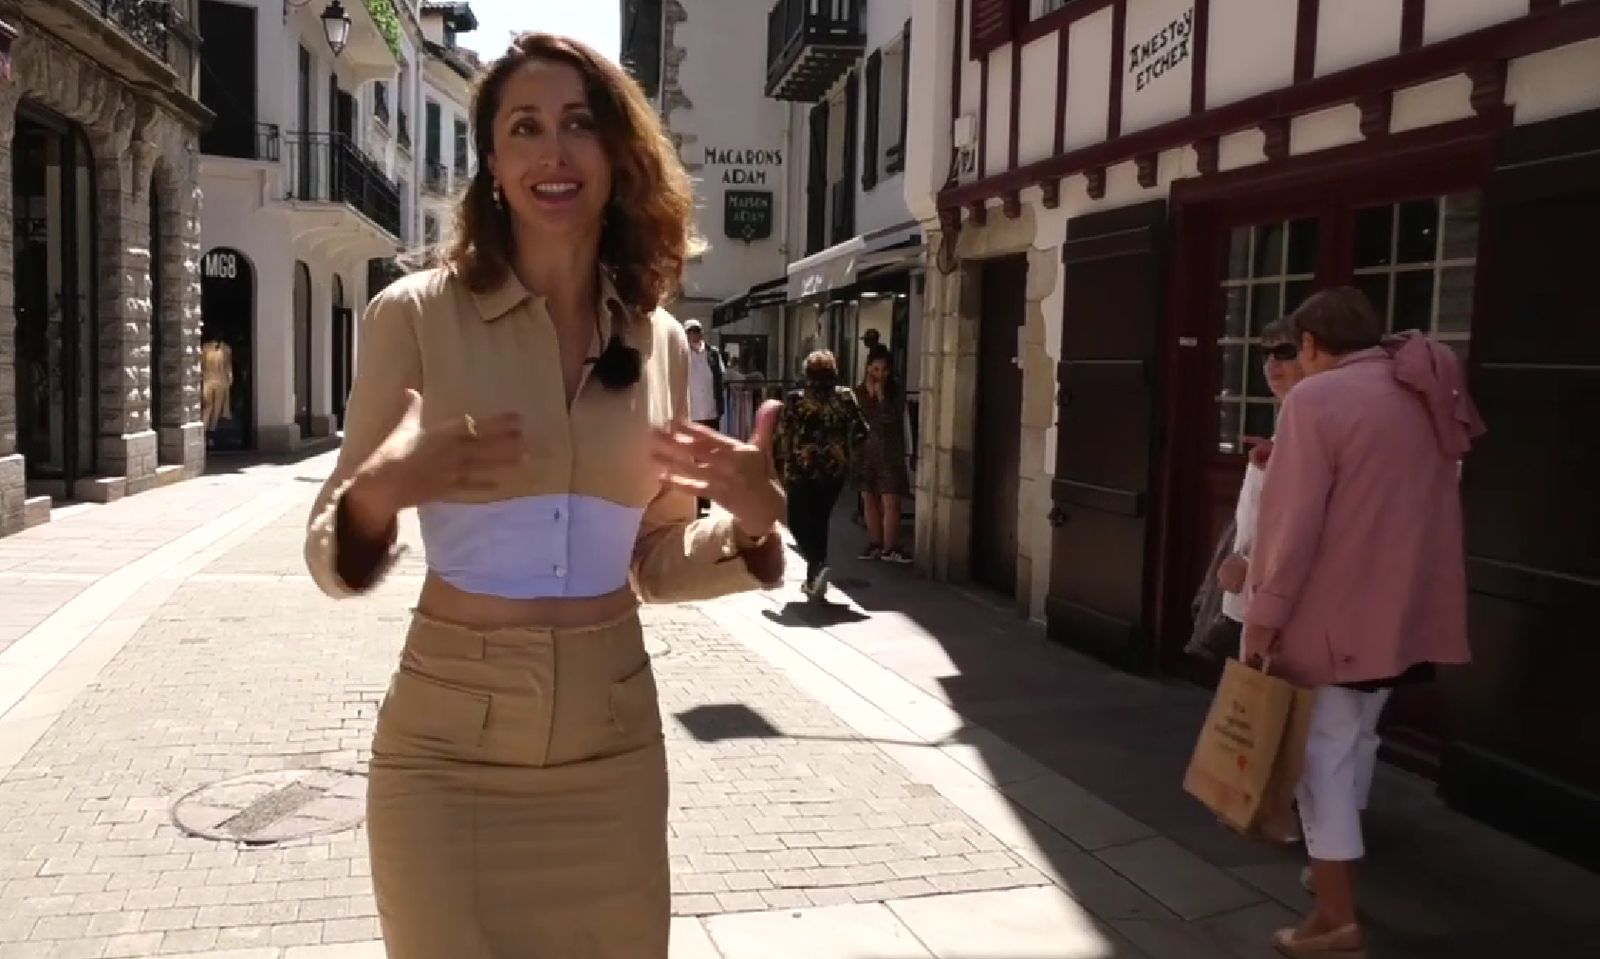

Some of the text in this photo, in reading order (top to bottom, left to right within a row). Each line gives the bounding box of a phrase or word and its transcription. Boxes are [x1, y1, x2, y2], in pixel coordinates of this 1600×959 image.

[1136, 38, 1189, 92] ETCHEA
[704, 146, 782, 166] MACARONS
[721, 169, 766, 184] ADAM
